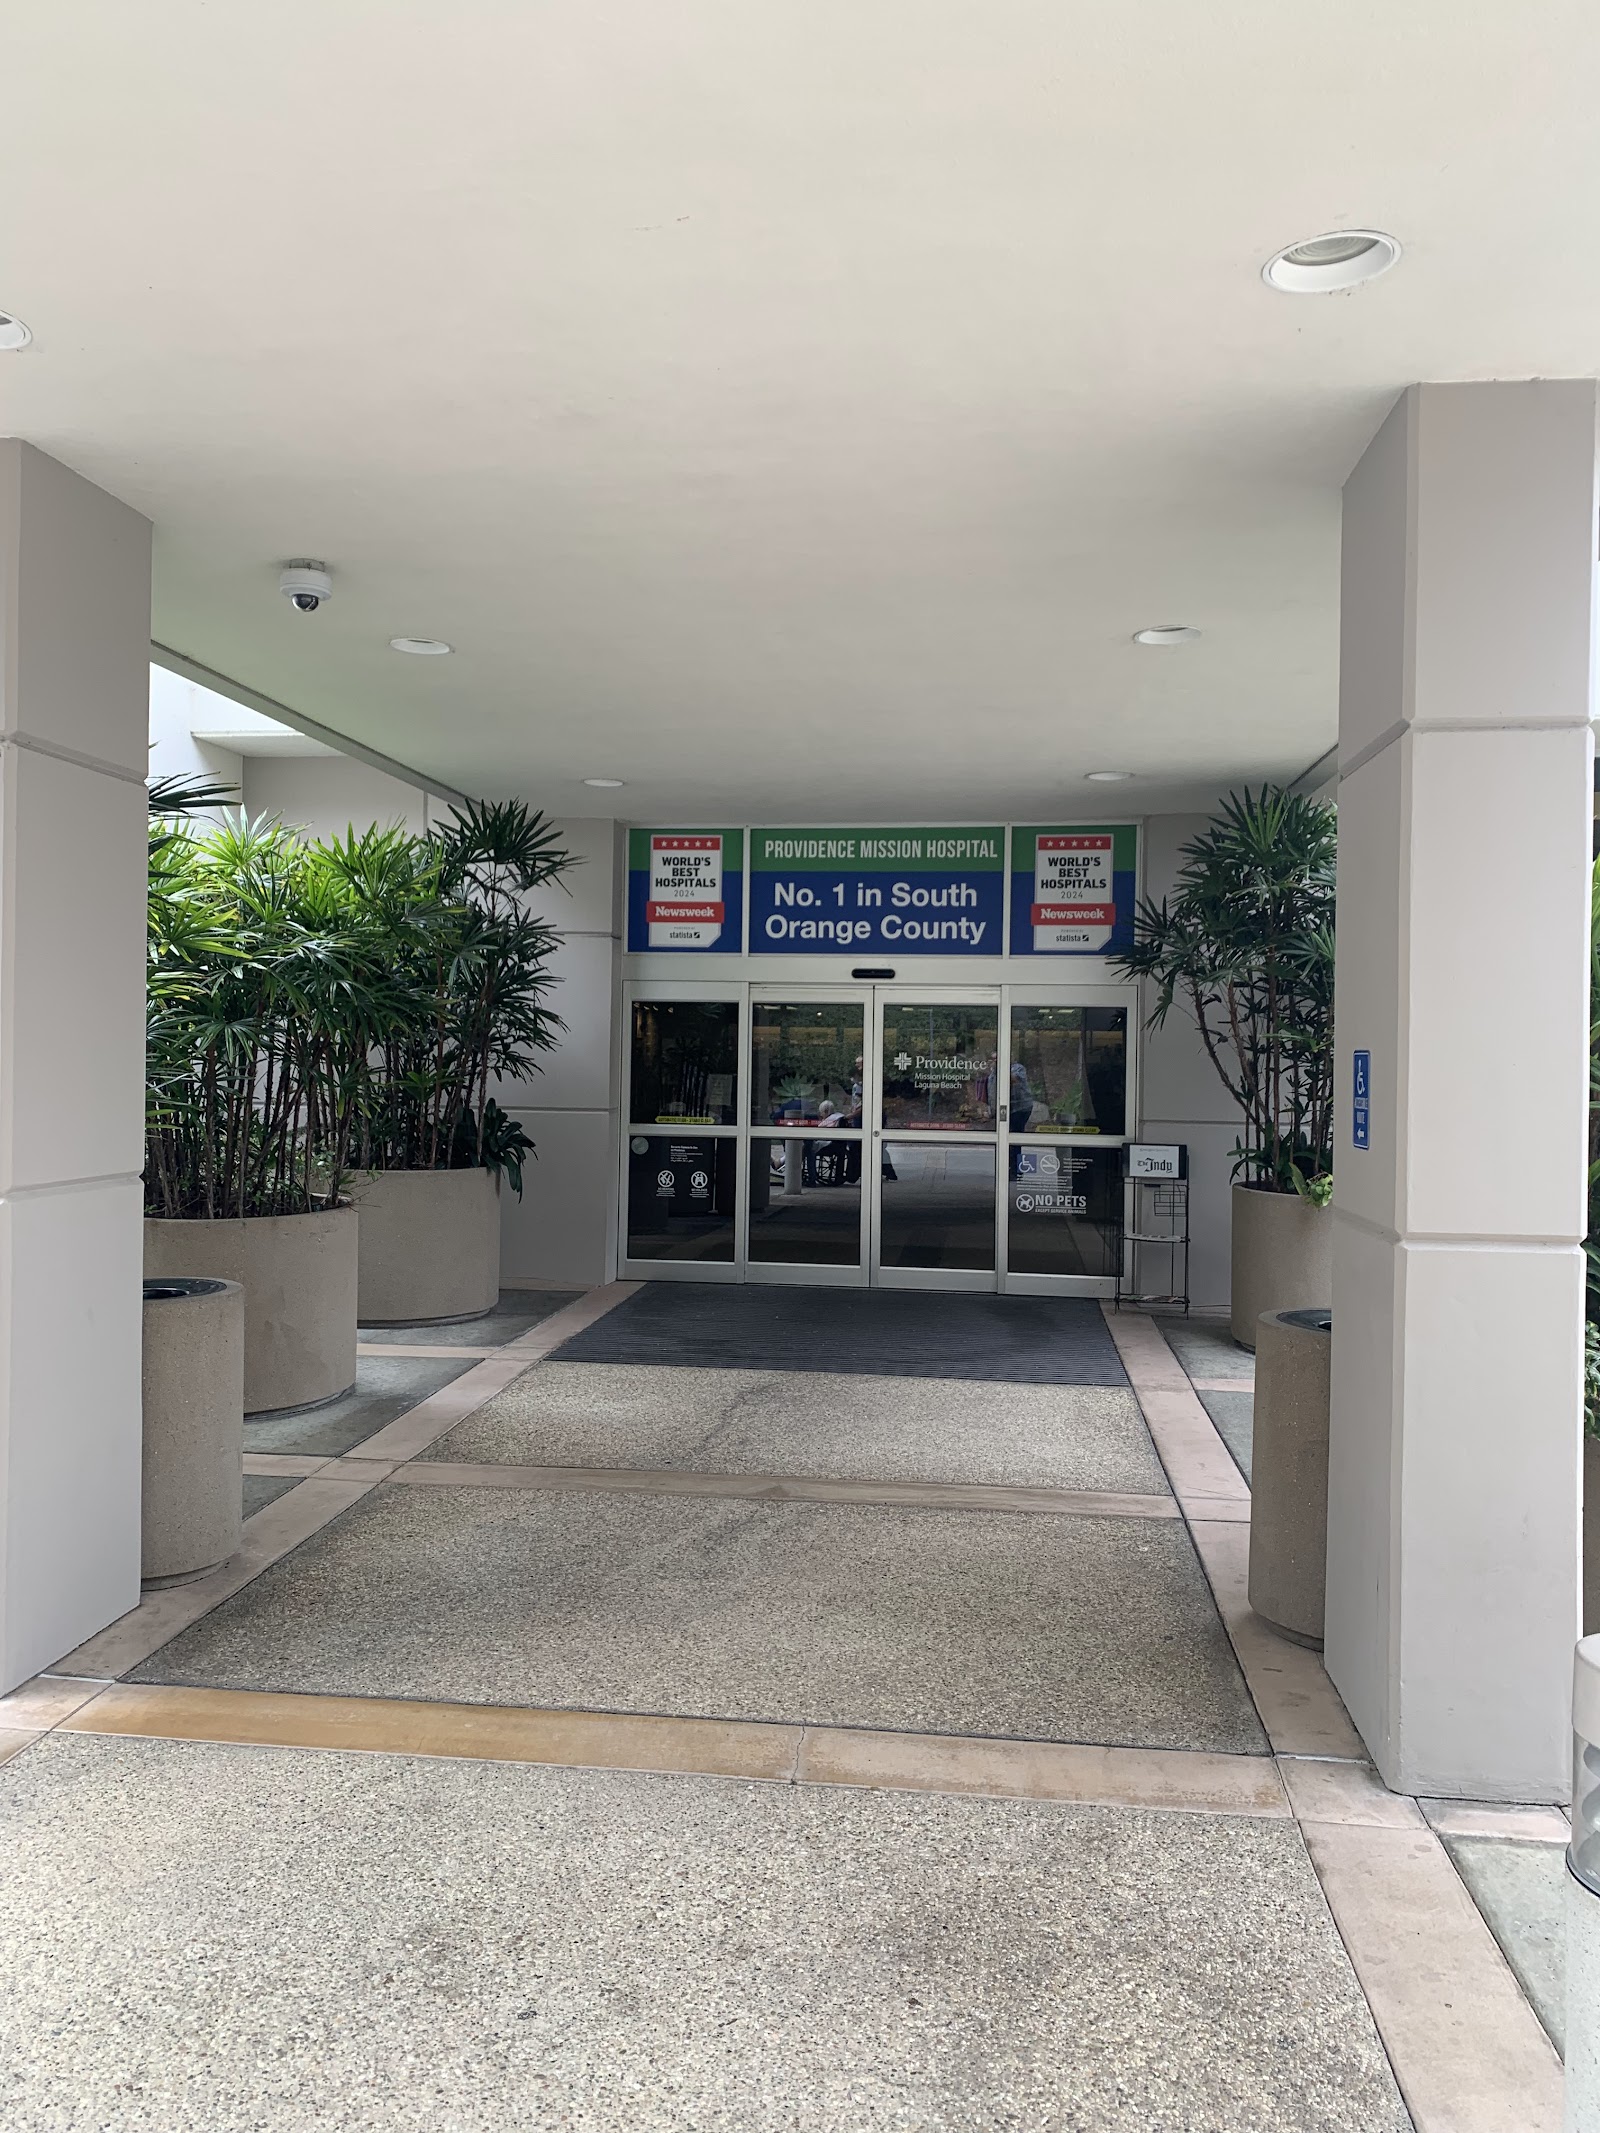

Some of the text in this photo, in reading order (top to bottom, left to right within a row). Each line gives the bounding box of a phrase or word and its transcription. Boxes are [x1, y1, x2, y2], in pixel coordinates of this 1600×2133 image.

[765, 840, 997, 858] PROVIDENCE MISSION HOSPITAL
[662, 857, 710, 866] WORLD'S
[1048, 857, 1100, 866] WORLD'S
[672, 867, 700, 876] BEST
[1059, 868, 1088, 877] BEST
[655, 878, 716, 887] HOSPITALS
[1041, 879, 1106, 888] HOSPITALS
[774, 882, 977, 907] No. 1 in South
[1061, 891, 1083, 899] 2024
[655, 906, 714, 917] Newsweek
[1040, 908, 1104, 919] Newsweek
[765, 914, 986, 945] Orange County
[670, 931, 692, 939] statista
[1056, 934, 1081, 942] statista
[915, 1056, 987, 1070] Providence
[942, 1073, 970, 1081] Hospital
[914, 1081, 939, 1090] Laguna
[1144, 1157, 1173, 1173] Indy
[1035, 1194, 1086, 1207] NO PETS
